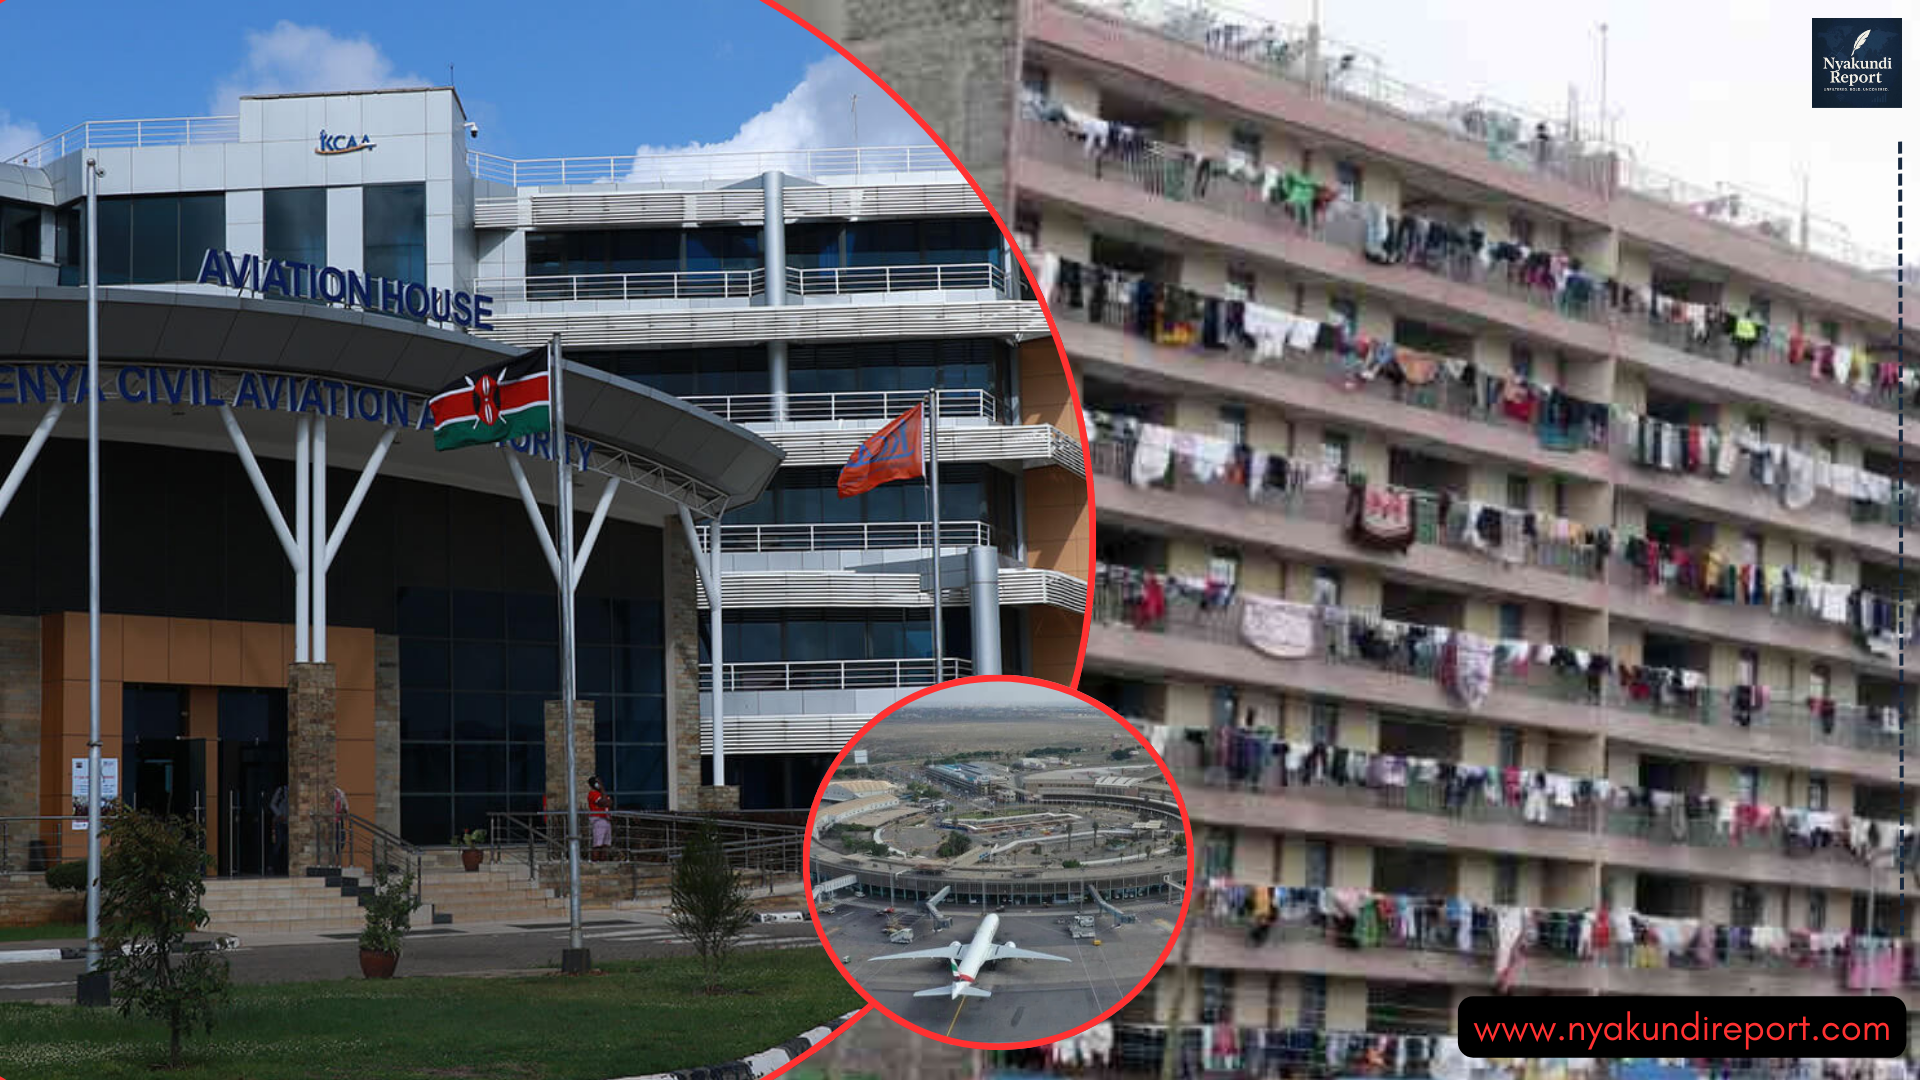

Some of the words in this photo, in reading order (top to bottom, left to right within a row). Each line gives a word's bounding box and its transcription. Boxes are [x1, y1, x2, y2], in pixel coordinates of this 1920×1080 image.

[319, 129, 374, 152] KCAA
[197, 248, 371, 308] AVIATION
[376, 276, 494, 331] HOUSE
[116, 365, 221, 406] CIVIL
[232, 372, 409, 427] AVIATION
